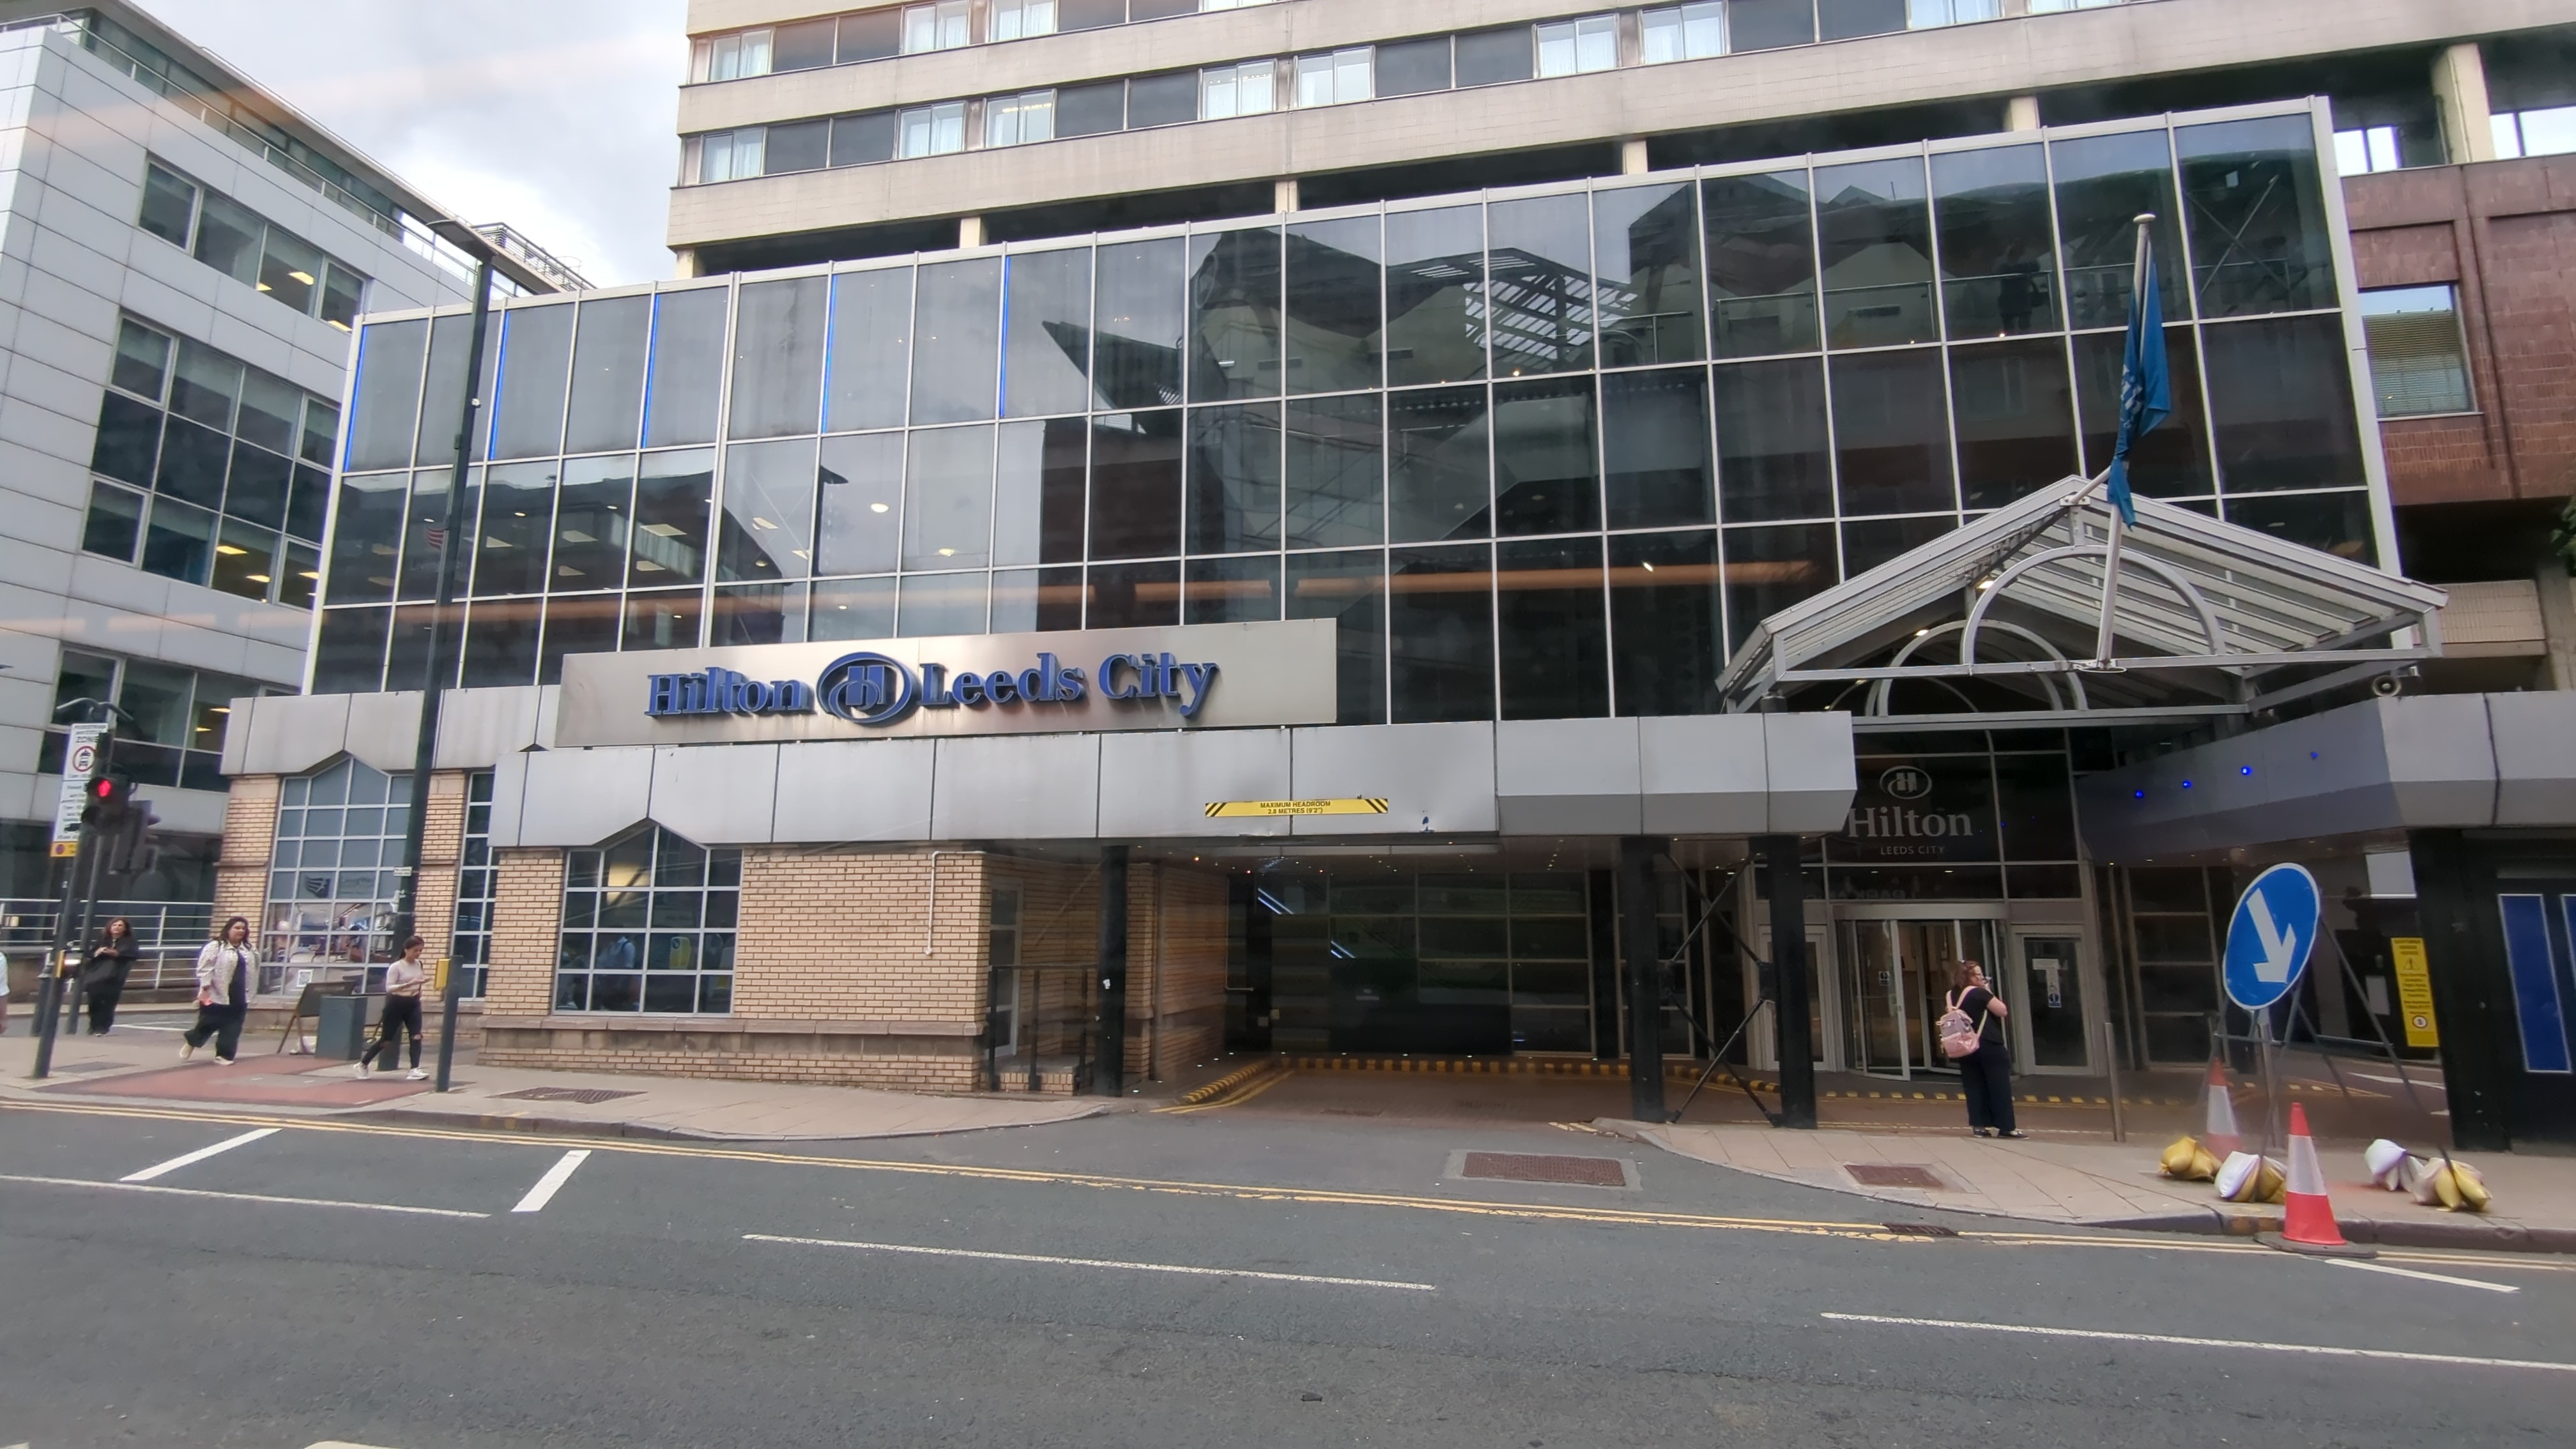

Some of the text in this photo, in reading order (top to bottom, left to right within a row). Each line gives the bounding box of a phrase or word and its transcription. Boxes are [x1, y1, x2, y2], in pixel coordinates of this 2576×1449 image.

[645, 666, 816, 717] Hilton
[917, 652, 1085, 705] Leeds
[1098, 652, 1221, 717] City
[1848, 806, 1974, 837] Hilton
[1880, 845, 1945, 855] LEEDS CITY
